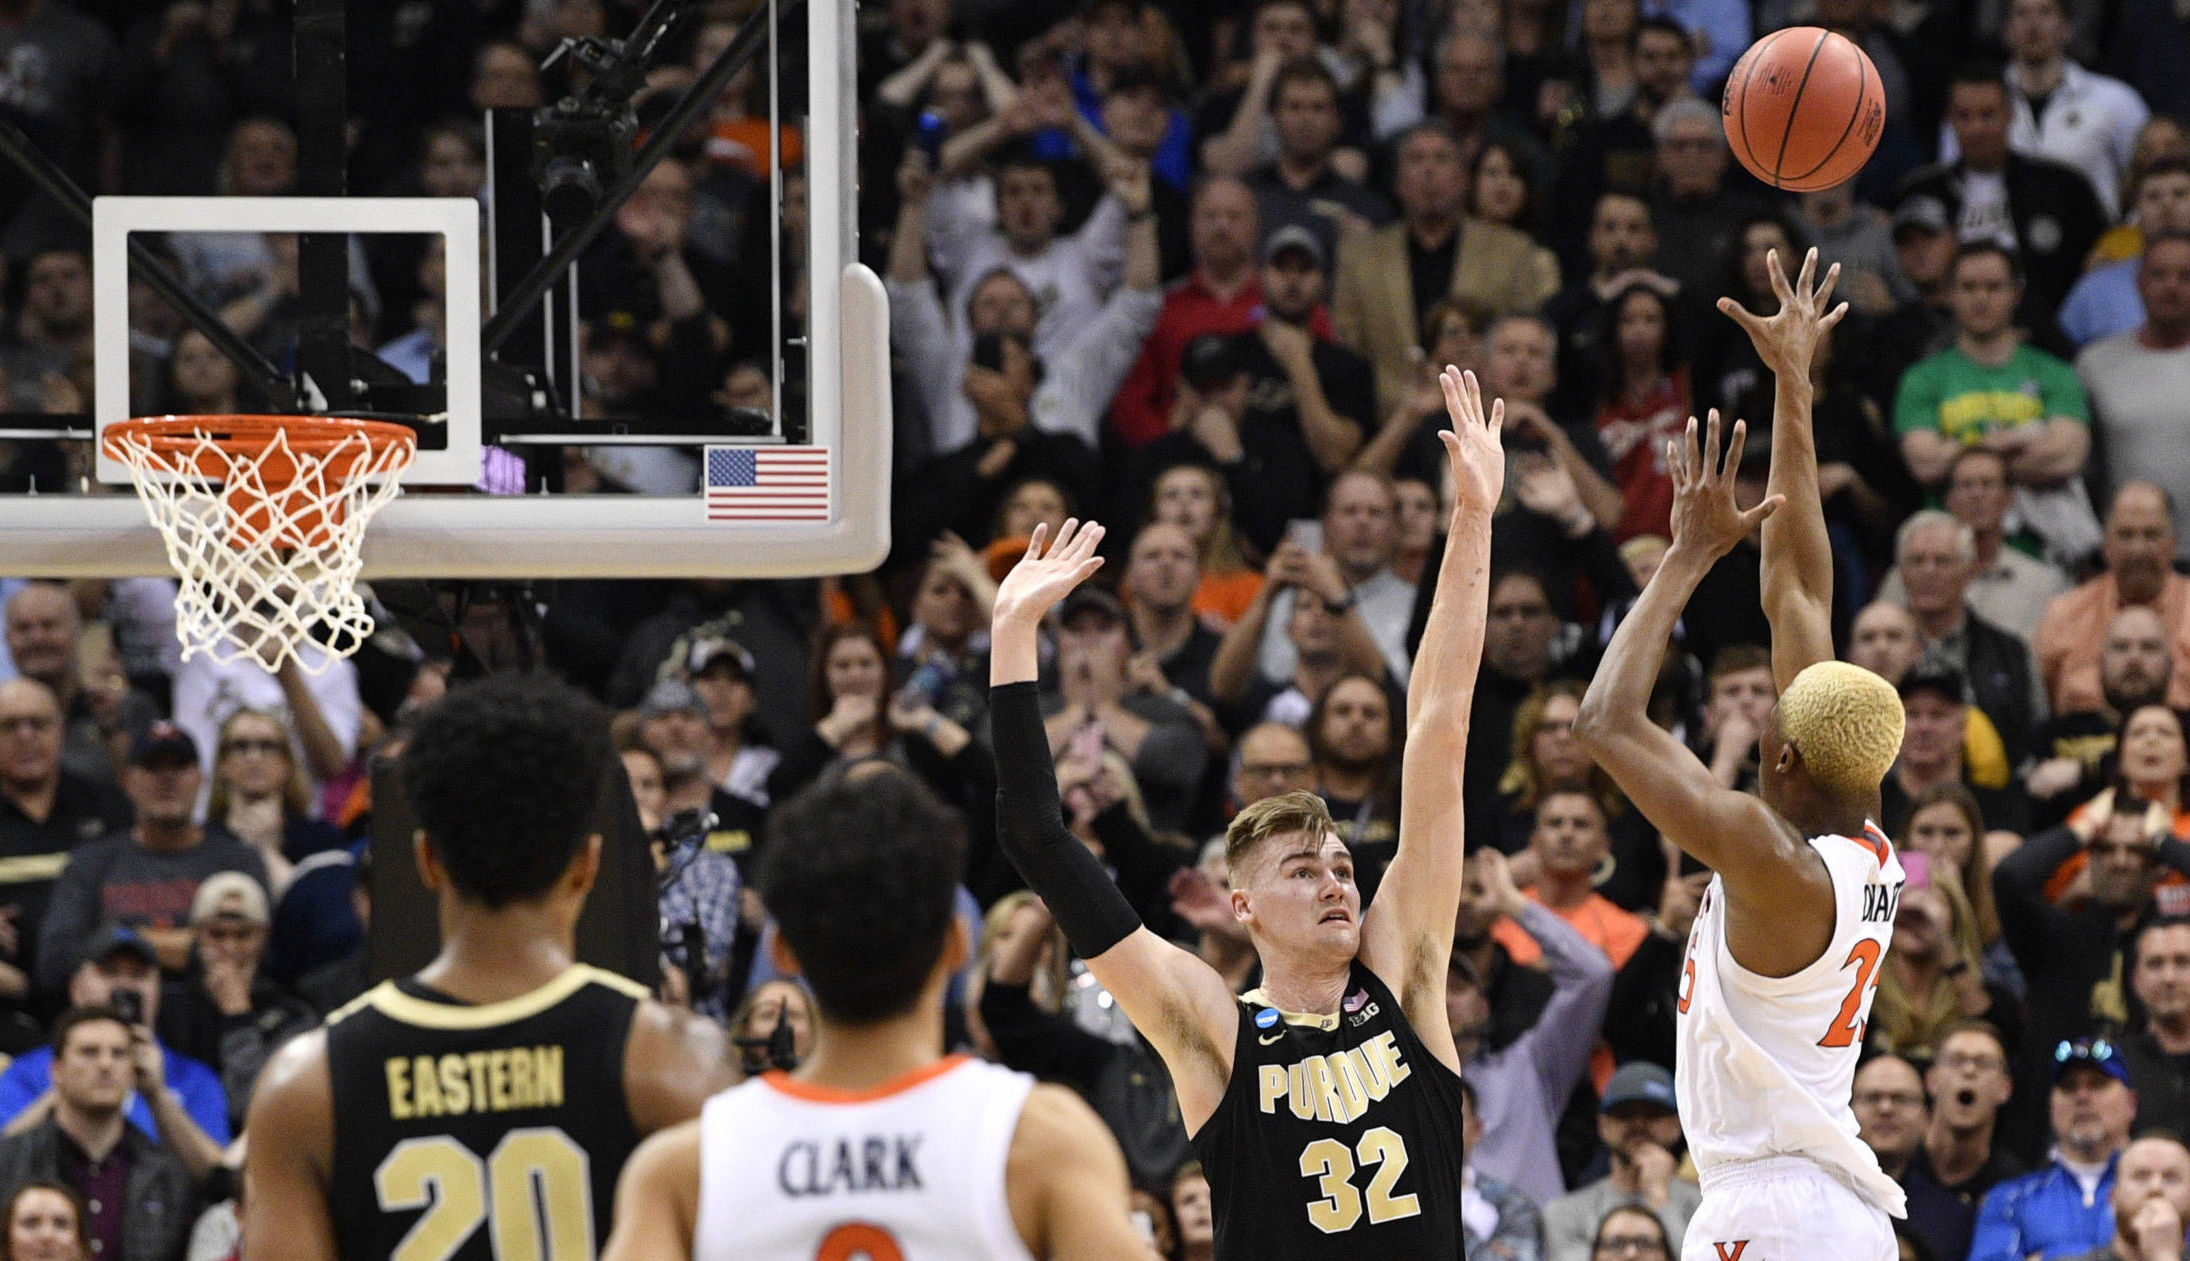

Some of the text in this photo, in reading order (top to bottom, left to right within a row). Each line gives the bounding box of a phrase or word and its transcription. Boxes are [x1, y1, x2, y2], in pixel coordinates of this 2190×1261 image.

[1816, 937, 1881, 1047] 2
[386, 1045, 564, 1120] EASTERN
[1258, 1029, 1412, 1125] PURDUE
[373, 1126, 597, 1261] 20
[776, 1132, 925, 1199] CLARK
[1299, 1126, 1421, 1234] 32
